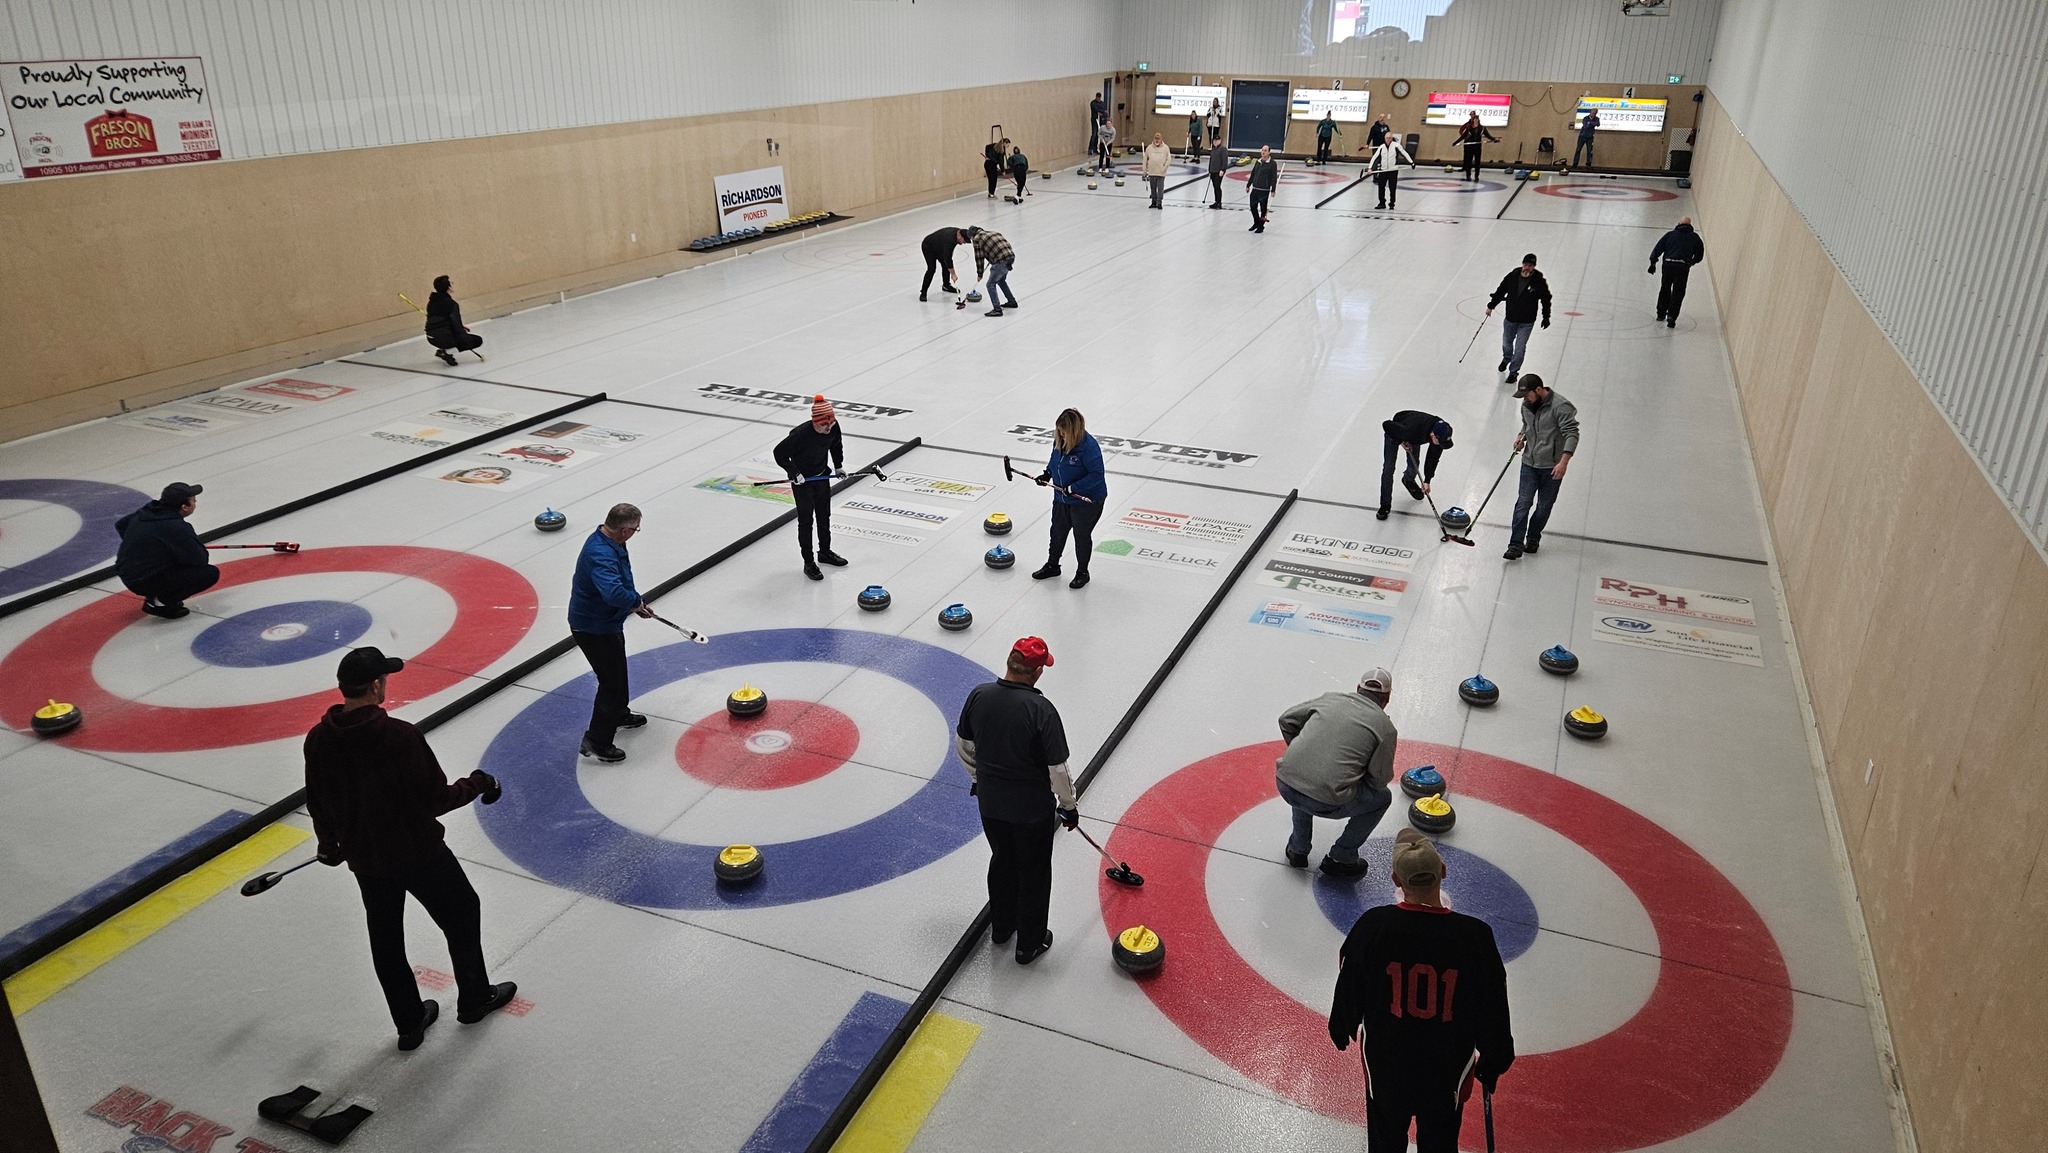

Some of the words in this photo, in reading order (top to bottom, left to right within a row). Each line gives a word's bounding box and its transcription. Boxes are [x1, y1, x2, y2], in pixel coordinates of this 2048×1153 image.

[19, 63, 93, 87] Proudly
[97, 61, 187, 83] Supporting
[1335, 80, 1341, 90] 2
[1470, 83, 1476, 93] 3
[1626, 87, 1633, 98] 4
[11, 94, 49, 109] Our
[52, 86, 105, 108] Local
[110, 83, 203, 104] Community
[90, 120, 151, 146] FRESON
[108, 160, 136, 168] Fairview
[743, 209, 768, 221] PIONEER
[1007, 425, 1258, 463] FARVIEW
[1128, 512, 1182, 525] ROYAL
[1291, 533, 1359, 550] BEYOND
[1362, 543, 1413, 559] 2000
[1137, 548, 1164, 558] Ed
[1169, 553, 1219, 567] Luck
[1274, 563, 1315, 575] Kubota
[1318, 570, 1365, 583] Country
[1274, 574, 1386, 601] Foster's
[1308, 612, 1382, 628] ADVENTURE
[1702, 639, 1753, 650] Financial
[1386, 961, 1459, 1023] 101
